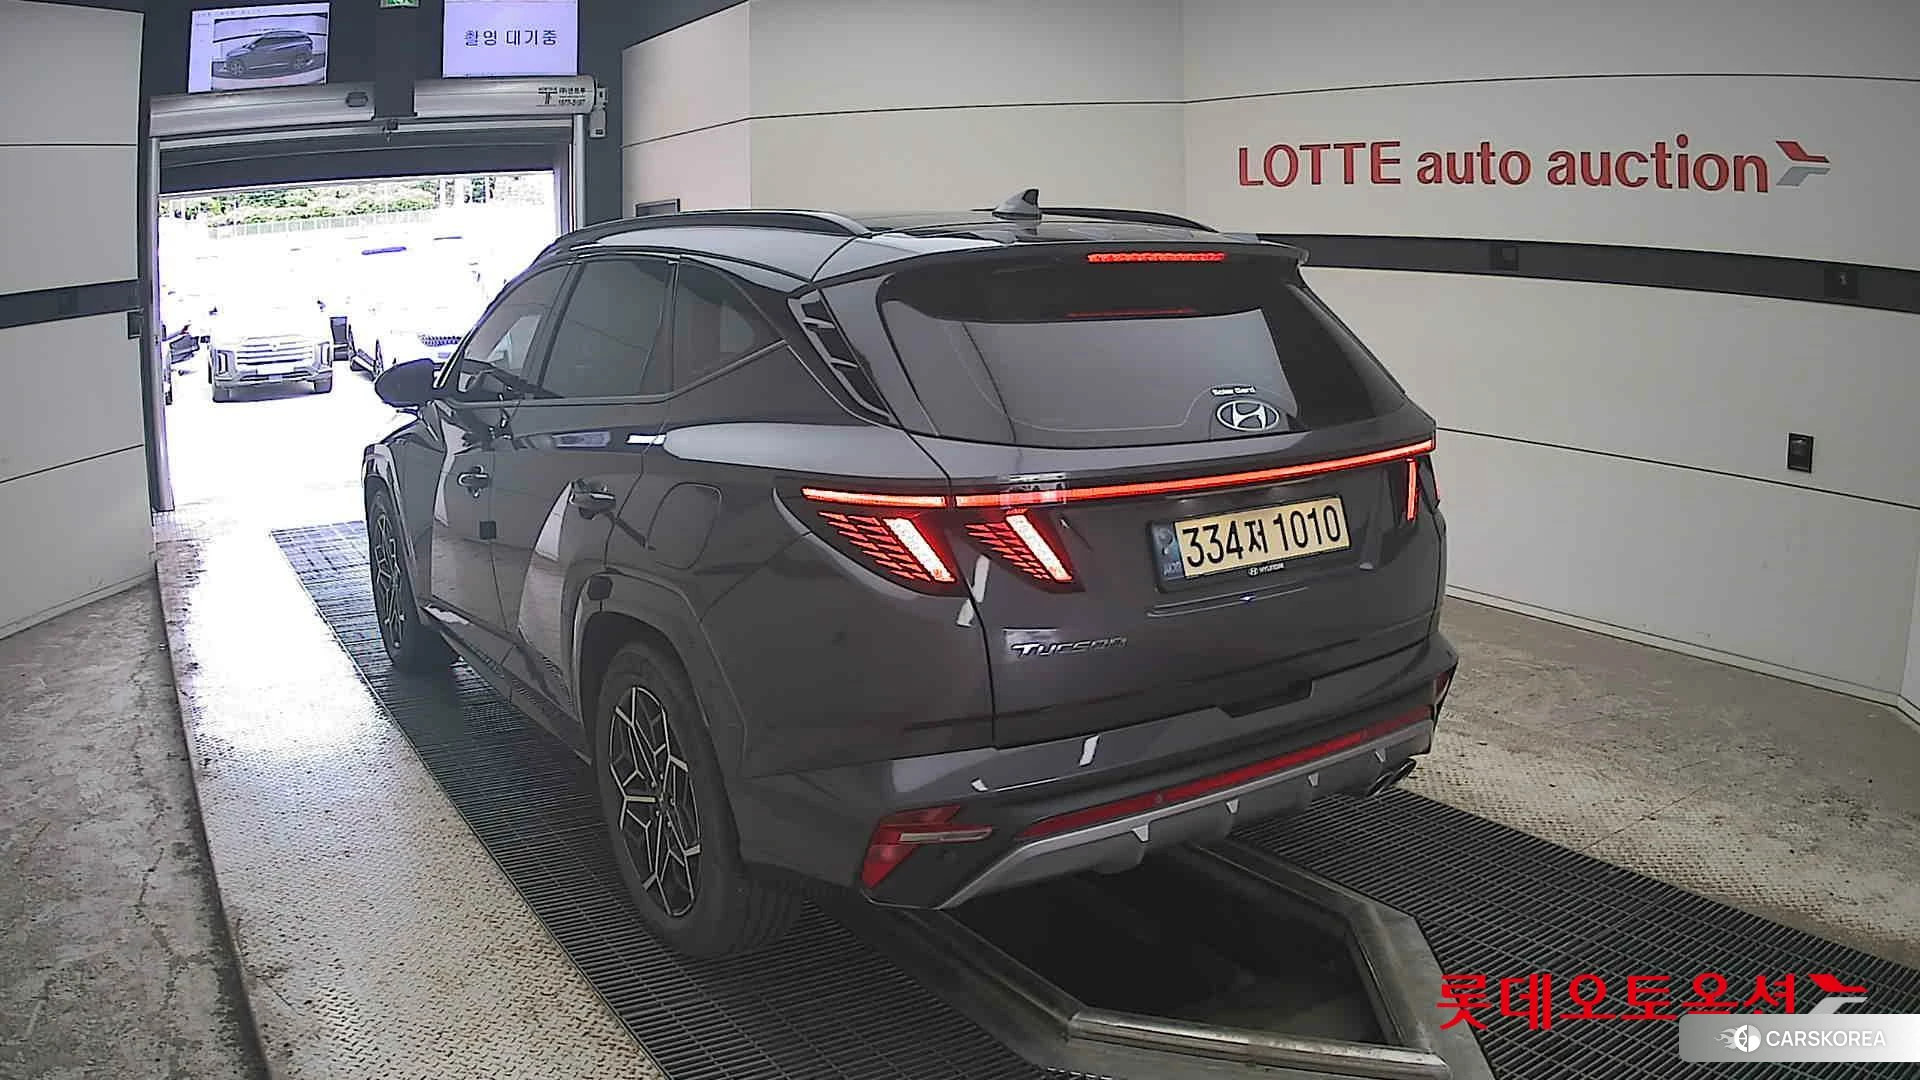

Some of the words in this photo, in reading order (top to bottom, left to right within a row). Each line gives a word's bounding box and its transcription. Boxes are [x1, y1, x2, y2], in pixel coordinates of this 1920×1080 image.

[505, 29, 558, 46] 대기중
[1238, 141, 1401, 188] LOTTE
[1416, 142, 1532, 186] auto
[1546, 134, 1769, 194] auction
[1182, 518, 1269, 568] 334저
[1273, 504, 1342, 552] 1010
